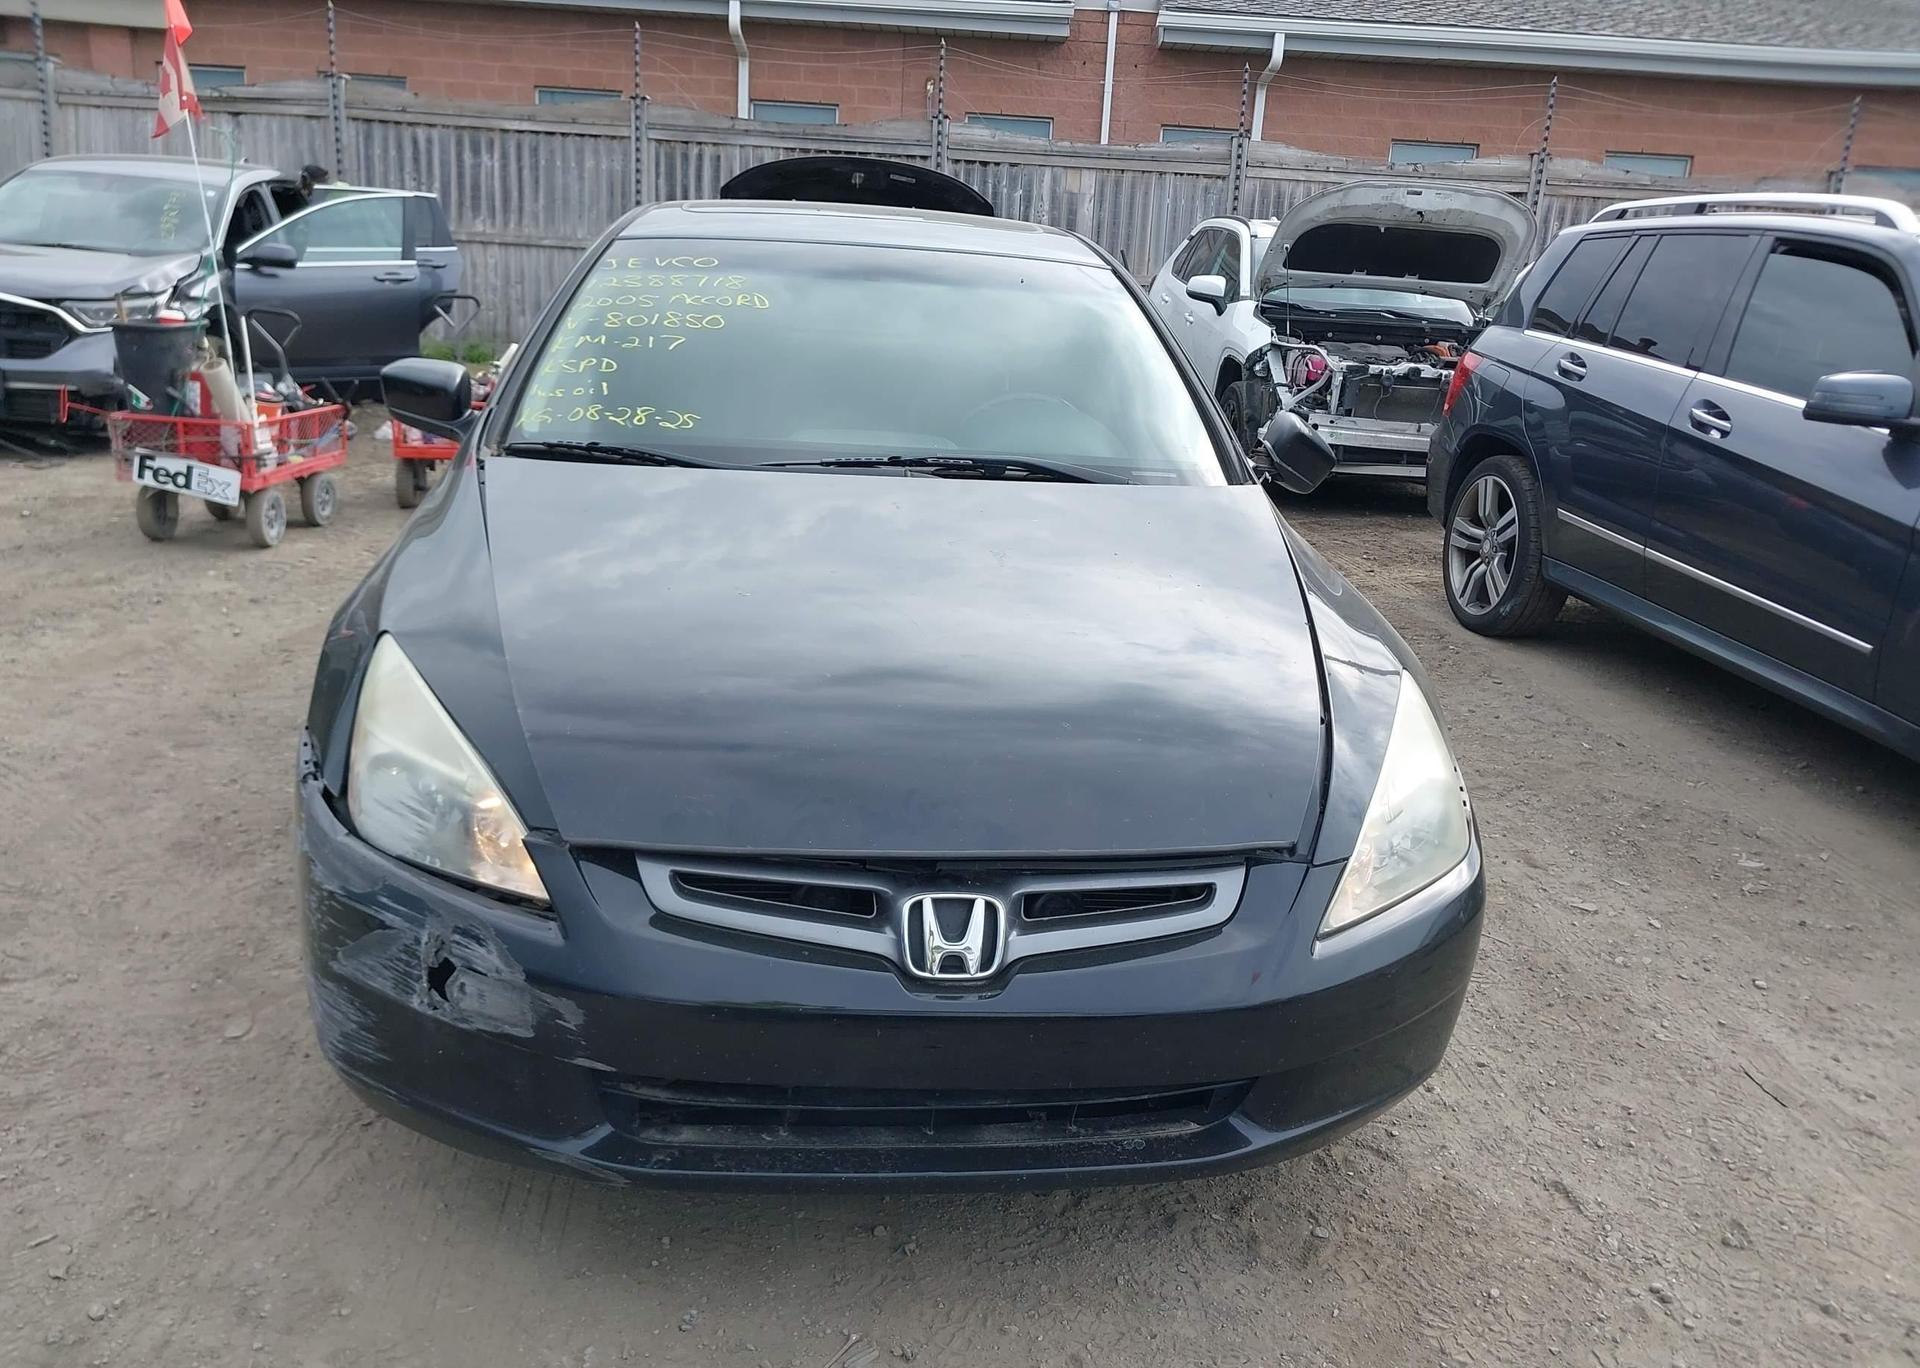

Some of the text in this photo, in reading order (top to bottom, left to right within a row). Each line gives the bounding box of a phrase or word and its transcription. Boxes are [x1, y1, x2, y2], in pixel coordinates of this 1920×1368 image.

[578, 291, 770, 309] 2005 ACCORD
[137, 454, 232, 501] FedEx
